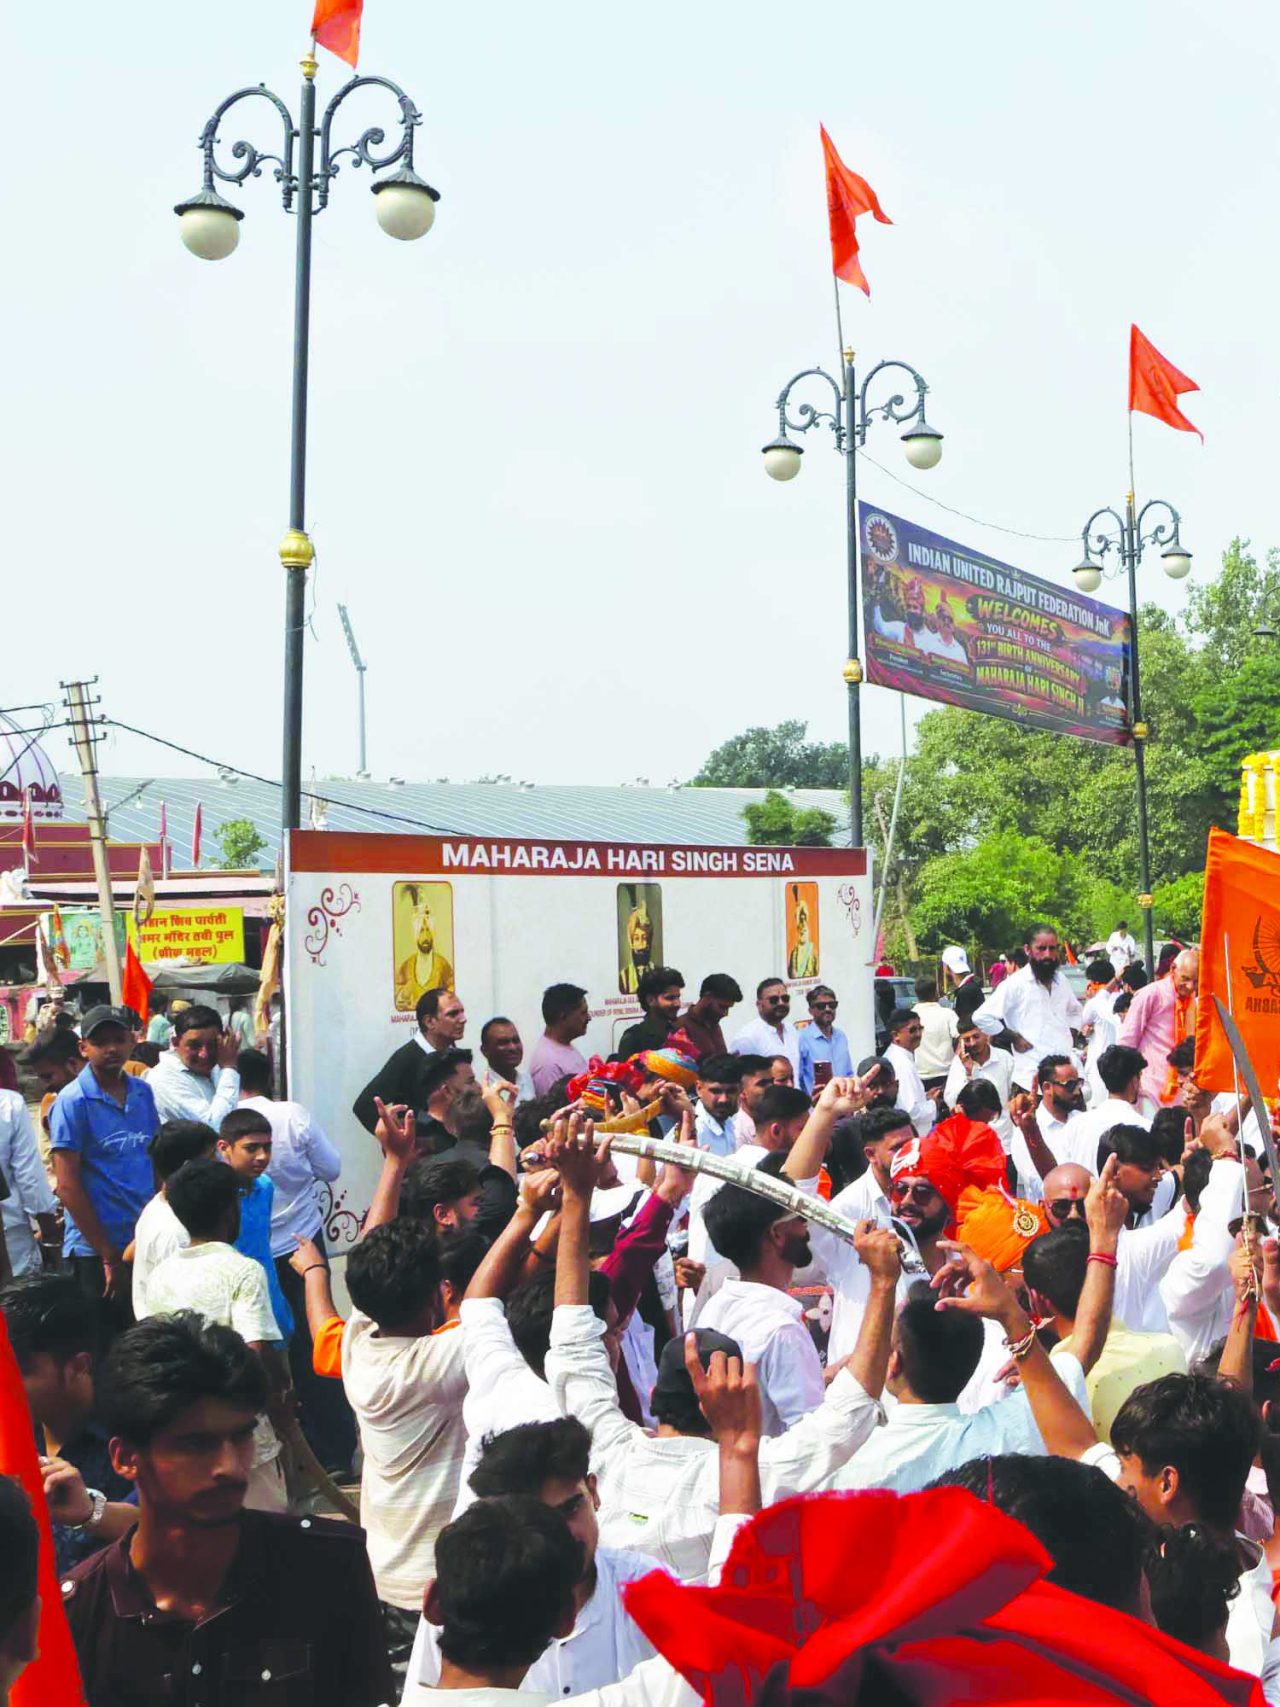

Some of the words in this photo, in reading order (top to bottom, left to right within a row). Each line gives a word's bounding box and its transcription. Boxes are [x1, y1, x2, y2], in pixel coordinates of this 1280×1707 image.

[908, 542, 950, 574] INDIAN
[953, 557, 995, 590] UNITED
[997, 575, 1036, 607] RAJPUT
[1039, 590, 1094, 629] FEDERATION
[1095, 617, 1110, 637] JnK
[978, 598, 1057, 639] WELCOMES
[987, 623, 1004, 635] YOU
[1007, 630, 1022, 642] ALL
[1024, 634, 1034, 645] TO
[1037, 637, 1051, 652] THE
[998, 642, 1023, 661] BIRTH
[1026, 650, 1080, 690] ANNIVERSARY
[976, 666, 1025, 694] MAHARAJA
[1026, 675, 1050, 699] HARI
[1051, 683, 1076, 711] SINGH
[442, 842, 601, 870] MAHARAJA
[607, 849, 664, 871] HARI
[671, 851, 738, 872] SINGH
[743, 852, 794, 872] SENA
